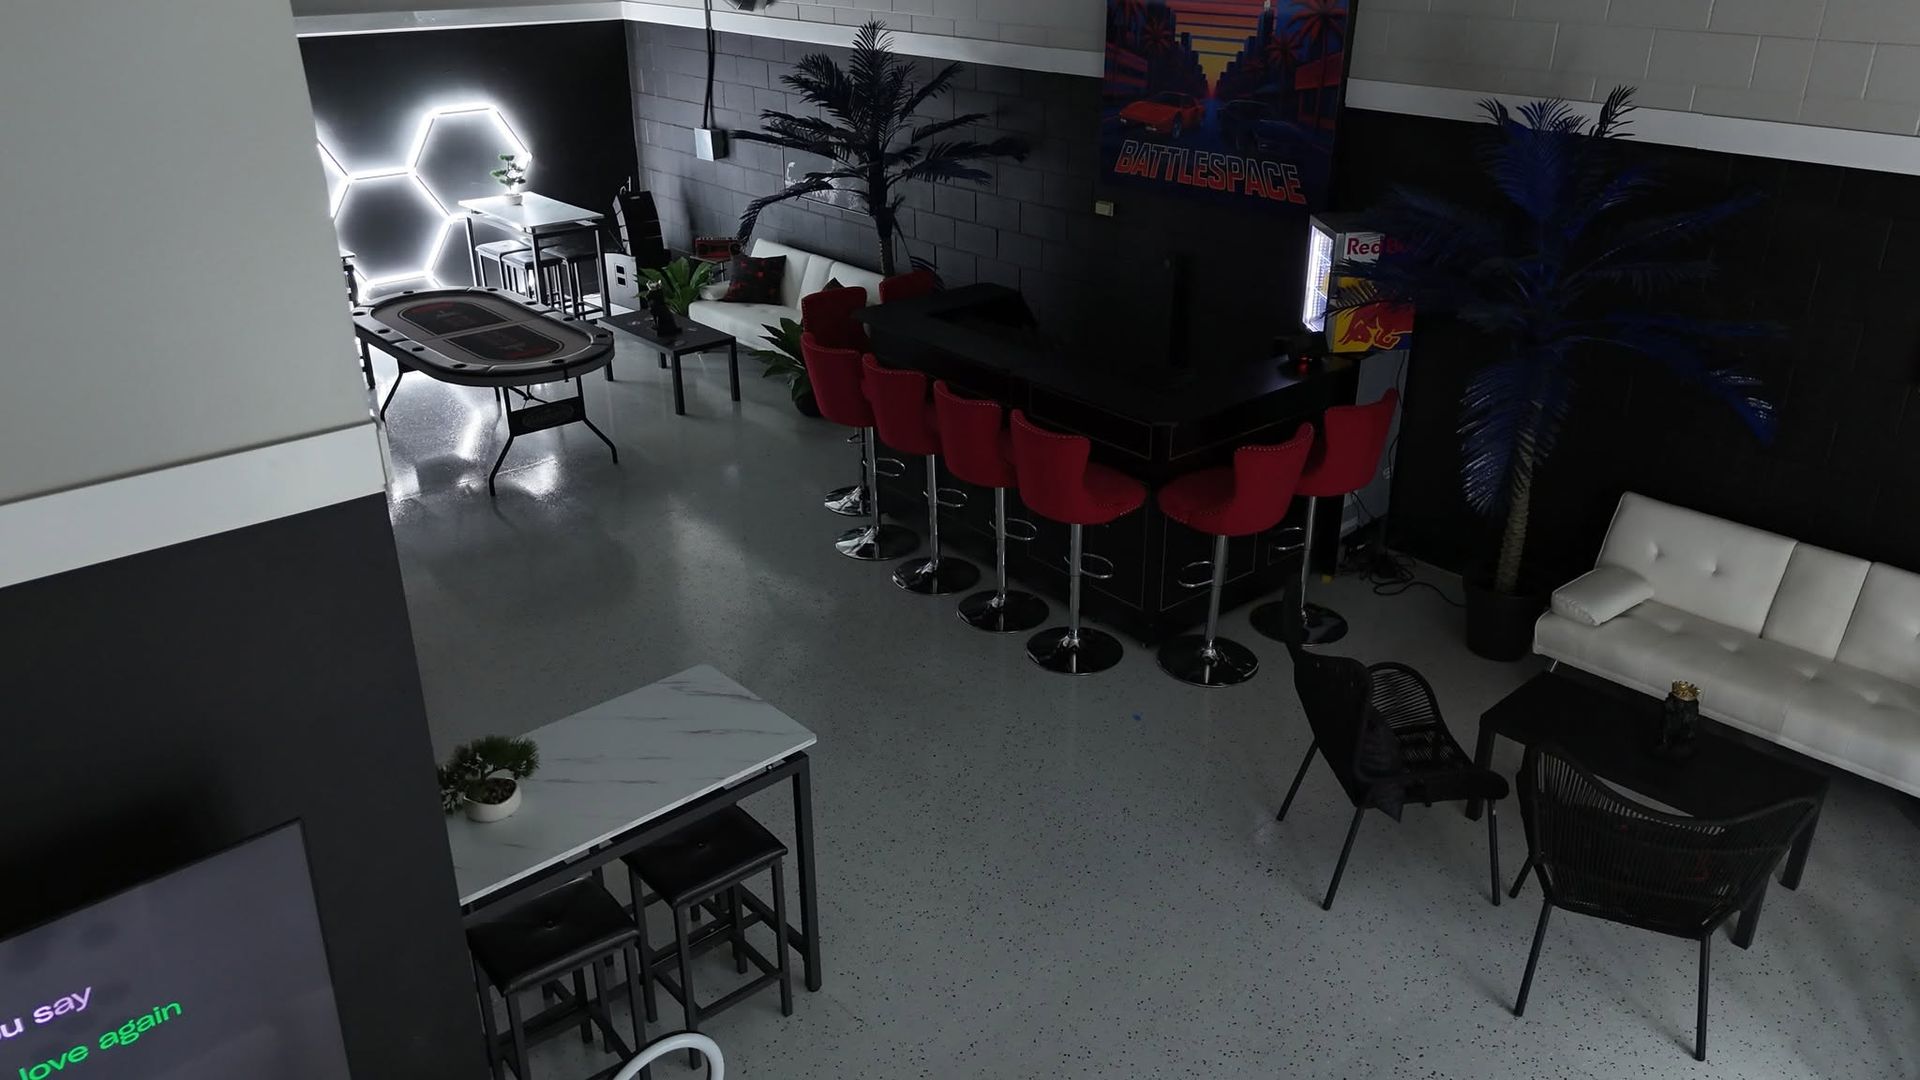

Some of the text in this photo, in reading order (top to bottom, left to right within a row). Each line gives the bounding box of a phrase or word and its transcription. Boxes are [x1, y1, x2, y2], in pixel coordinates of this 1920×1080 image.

[1114, 139, 1308, 205] BATTLESPACE
[0, 986, 92, 1040] u say
[18, 1001, 183, 1080] love again
